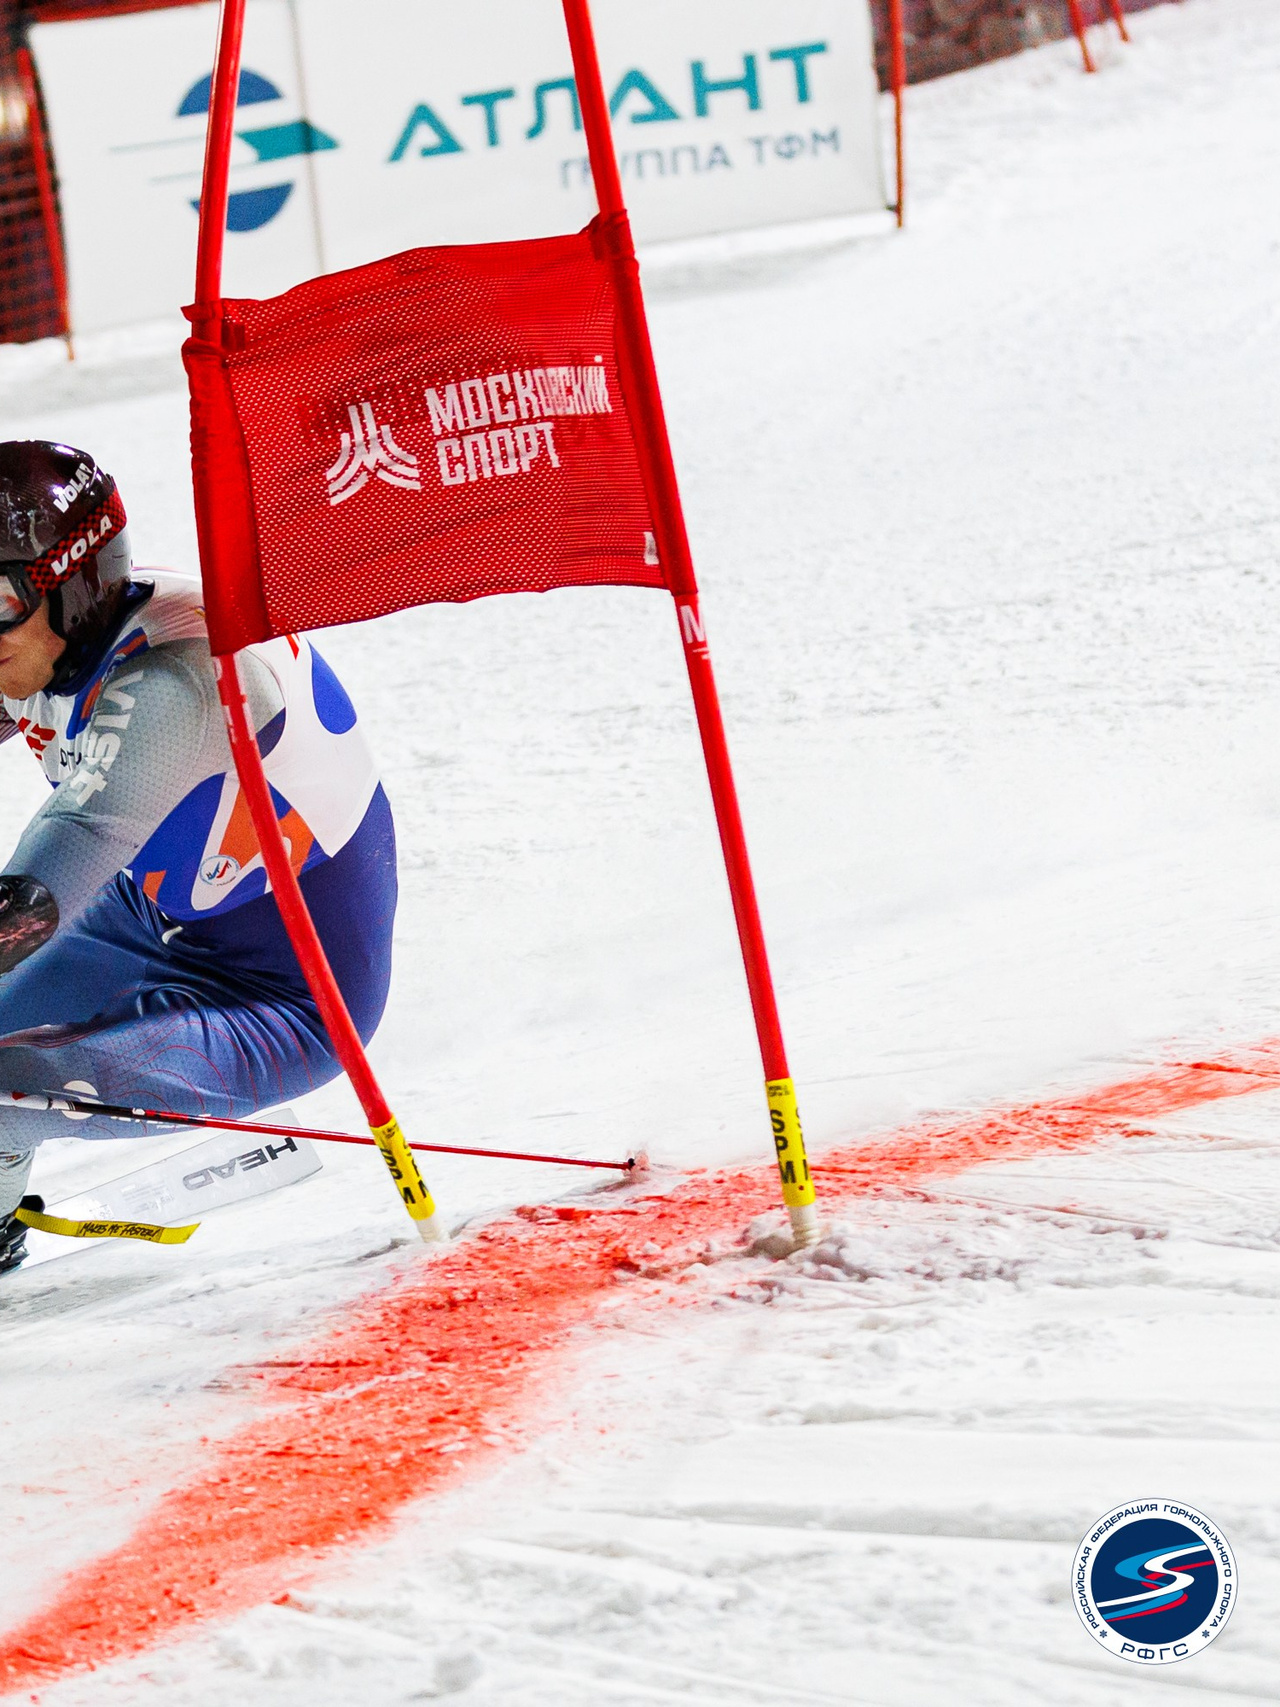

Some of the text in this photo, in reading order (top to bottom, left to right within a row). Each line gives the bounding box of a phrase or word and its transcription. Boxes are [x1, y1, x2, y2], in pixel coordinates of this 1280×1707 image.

[385, 40, 828, 164] АТЛАНТ
[560, 126, 840, 189] ГППА ТФМ
[437, 421, 562, 486] СПОРТ
[51, 514, 113, 576] VOLA
[70, 669, 144, 808] VIST
[182, 1136, 299, 1191] HEAD
